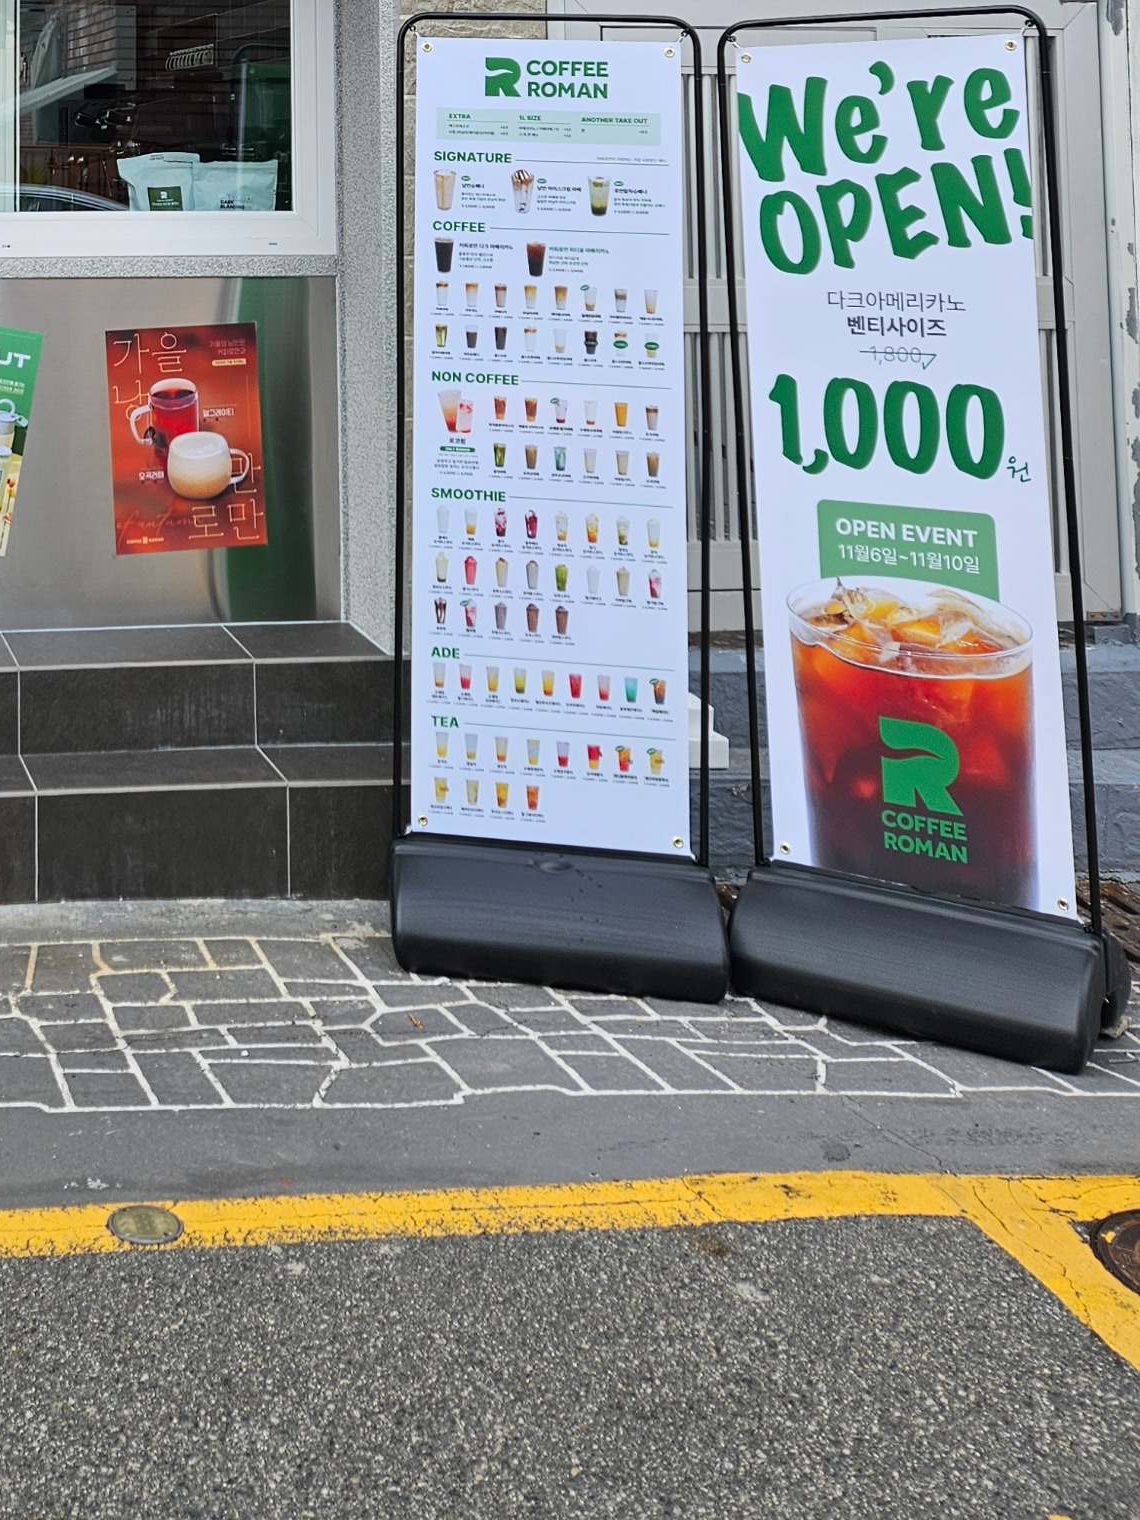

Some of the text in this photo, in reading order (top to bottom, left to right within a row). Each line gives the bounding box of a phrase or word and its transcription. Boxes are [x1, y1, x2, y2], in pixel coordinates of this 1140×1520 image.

[526, 60, 609, 78] COFFEE
[527, 81, 608, 99] ROMAN
[738, 61, 1020, 182] We're
[433, 151, 512, 163] SIGNATURE
[760, 147, 1034, 275] OPEN!
[432, 220, 486, 233] COFFEE
[826, 290, 967, 314] 다크아메리카노
[847, 315, 947, 338] 벤티사이즈
[113, 331, 187, 374] 가을
[868, 346, 923, 366] 1,800
[431, 370, 519, 386] NON COFFEE
[769, 373, 1032, 483] 1,000 원
[431, 487, 506, 502] SMOOTHIE
[188, 497, 264, 540] 로만
[836, 517, 978, 549] OPEN EVENT
[838, 542, 980, 575] 11월6일~11월10일
[431, 646, 460, 659] ADE
[431, 715, 460, 729] TEA
[881, 809, 967, 841] COFFEE
[883, 831, 968, 865] ROMAN
